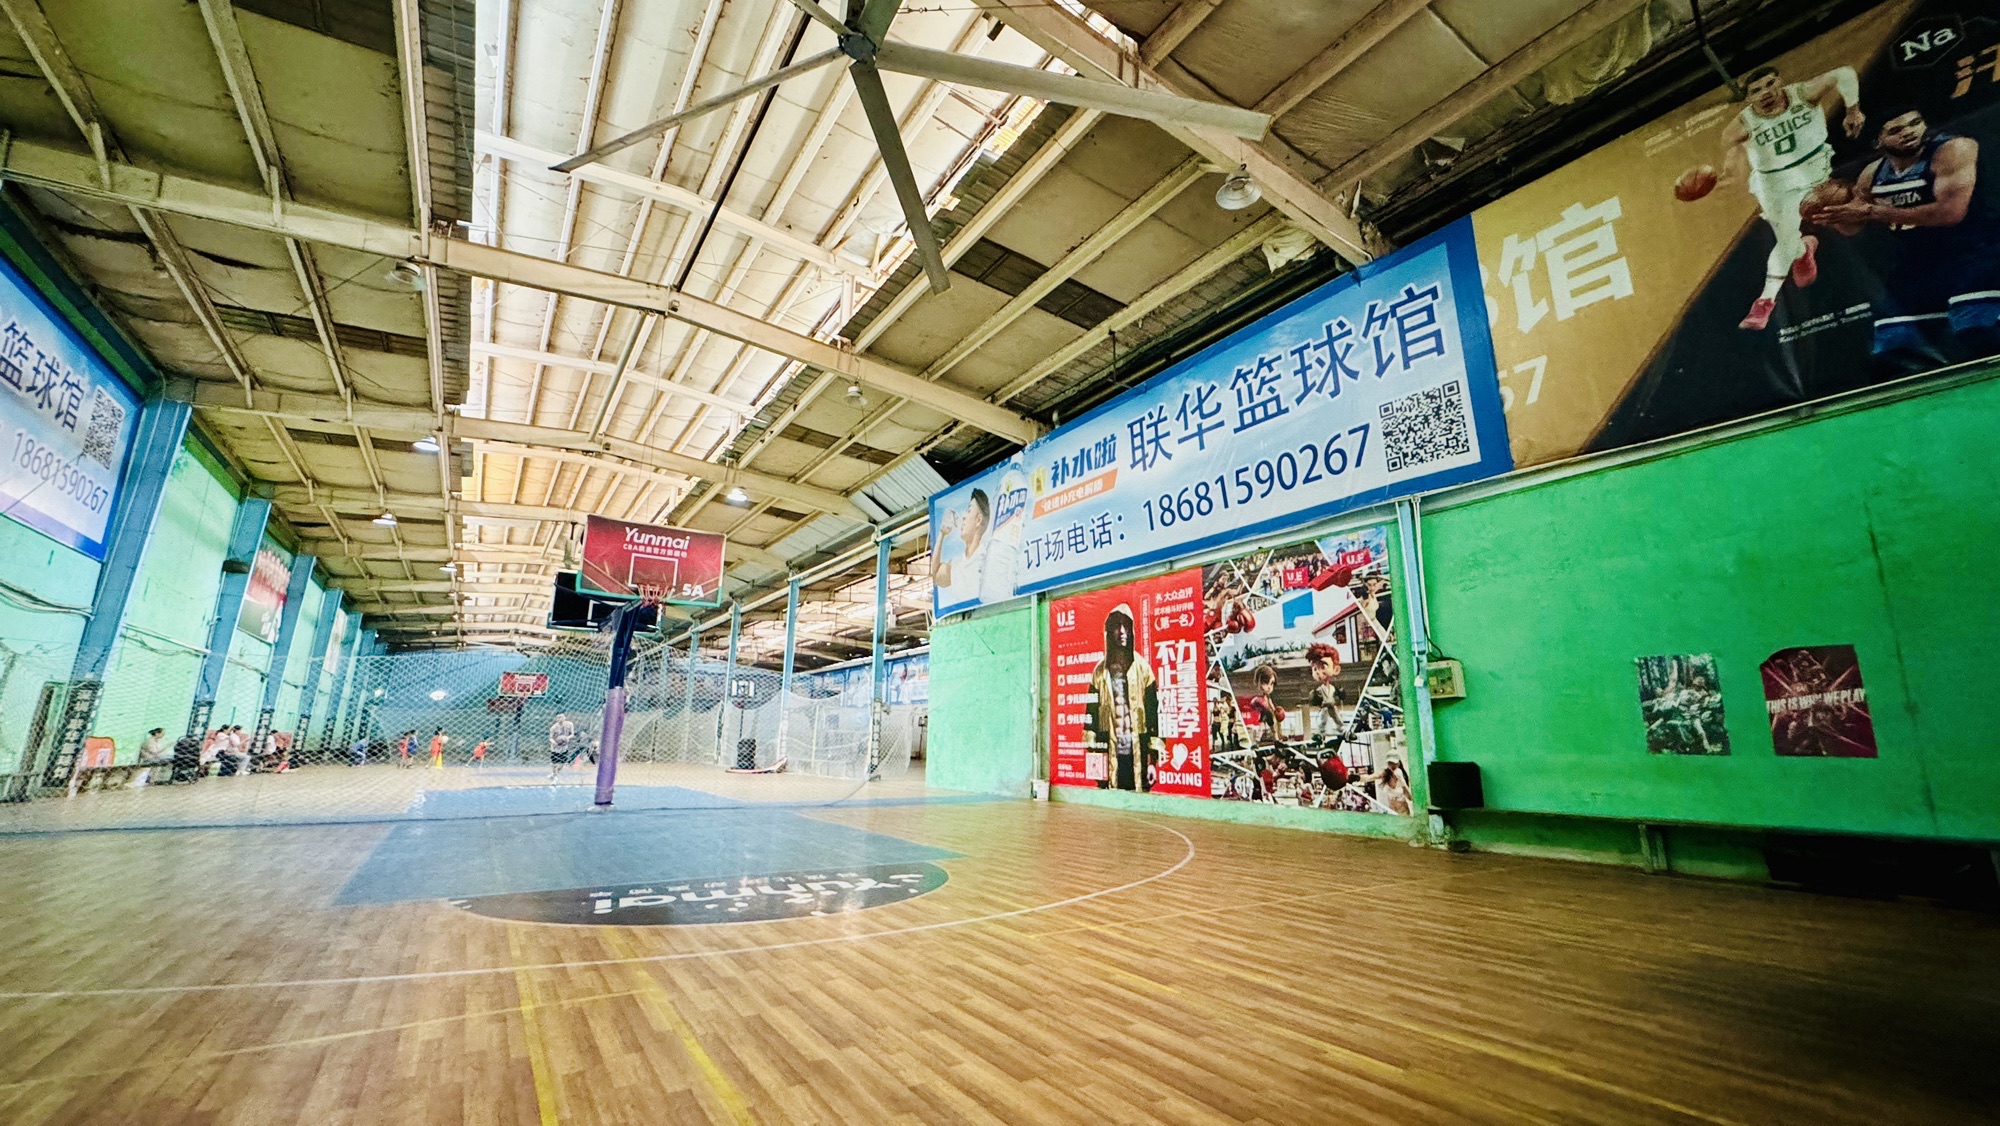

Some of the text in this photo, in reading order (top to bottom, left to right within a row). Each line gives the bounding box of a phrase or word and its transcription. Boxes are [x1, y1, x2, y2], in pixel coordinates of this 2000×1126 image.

[1900, 27, 1957, 61] Na
[1756, 110, 1812, 146] CELTICS
[1774, 132, 1797, 155] 0
[1480, 196, 1635, 334] 馆
[0, 321, 85, 434] 篮球馆
[1126, 286, 1446, 474] 联华篮球馆
[11, 432, 109, 516] 18681590267
[1050, 433, 1117, 489] 补水啦
[1142, 422, 1371, 532] 18681590267
[625, 526, 691, 550] Yunmai
[682, 583, 705, 598] 5A
[1163, 586, 1194, 603] 大众点评
[1056, 609, 1076, 628] U.E
[1766, 698, 1787, 714] THIS
[1787, 697, 1799, 710] IS
[1841, 688, 1866, 704] PLAY
[1158, 770, 1203, 788] BOXING
